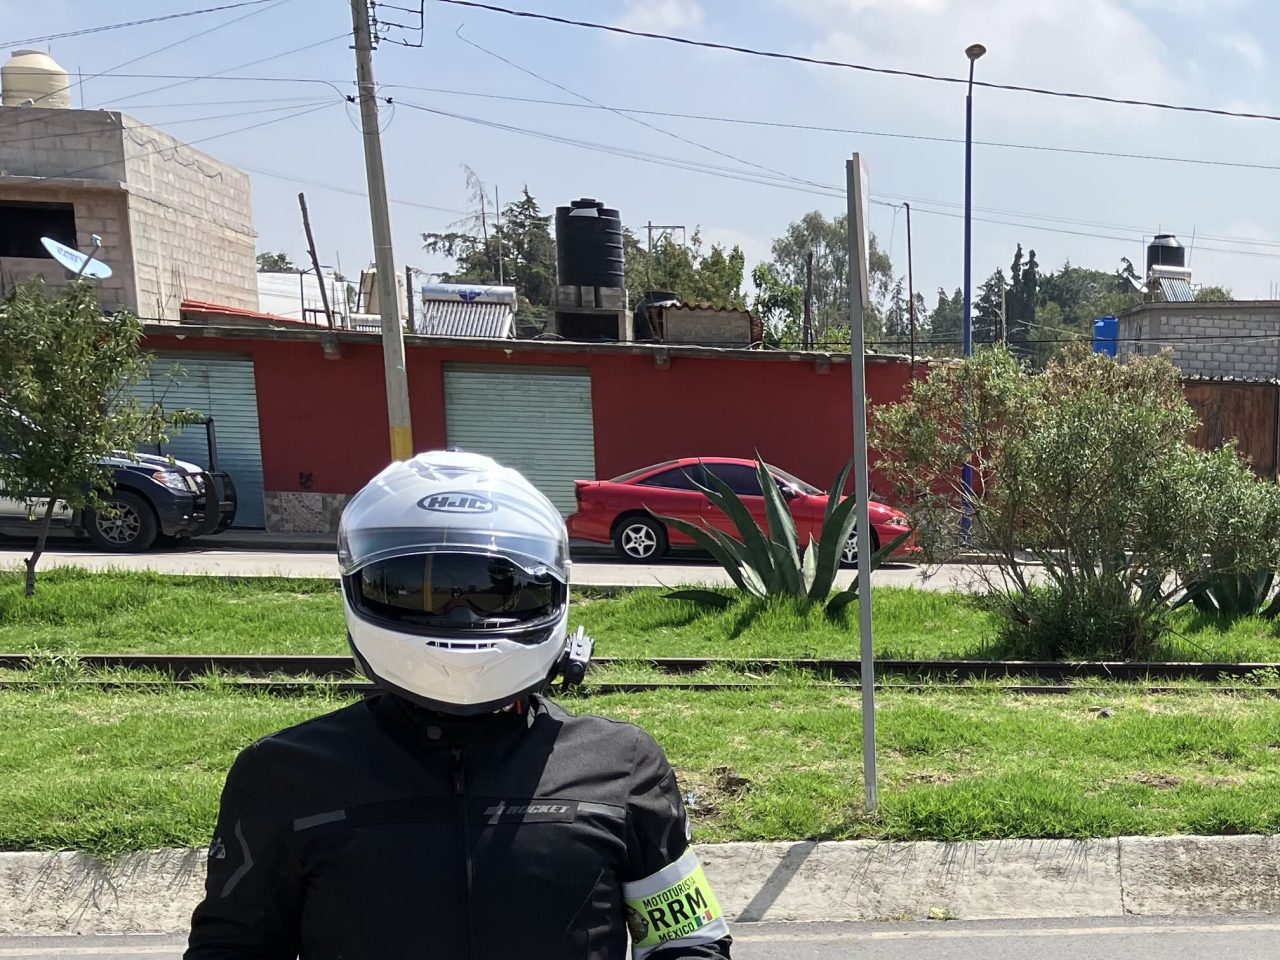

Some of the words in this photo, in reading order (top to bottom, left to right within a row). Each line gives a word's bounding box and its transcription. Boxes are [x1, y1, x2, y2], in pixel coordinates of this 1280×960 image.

[427, 496, 490, 510] HJC
[642, 876, 697, 910] MOTOTURISTA
[646, 886, 708, 932] RRM
